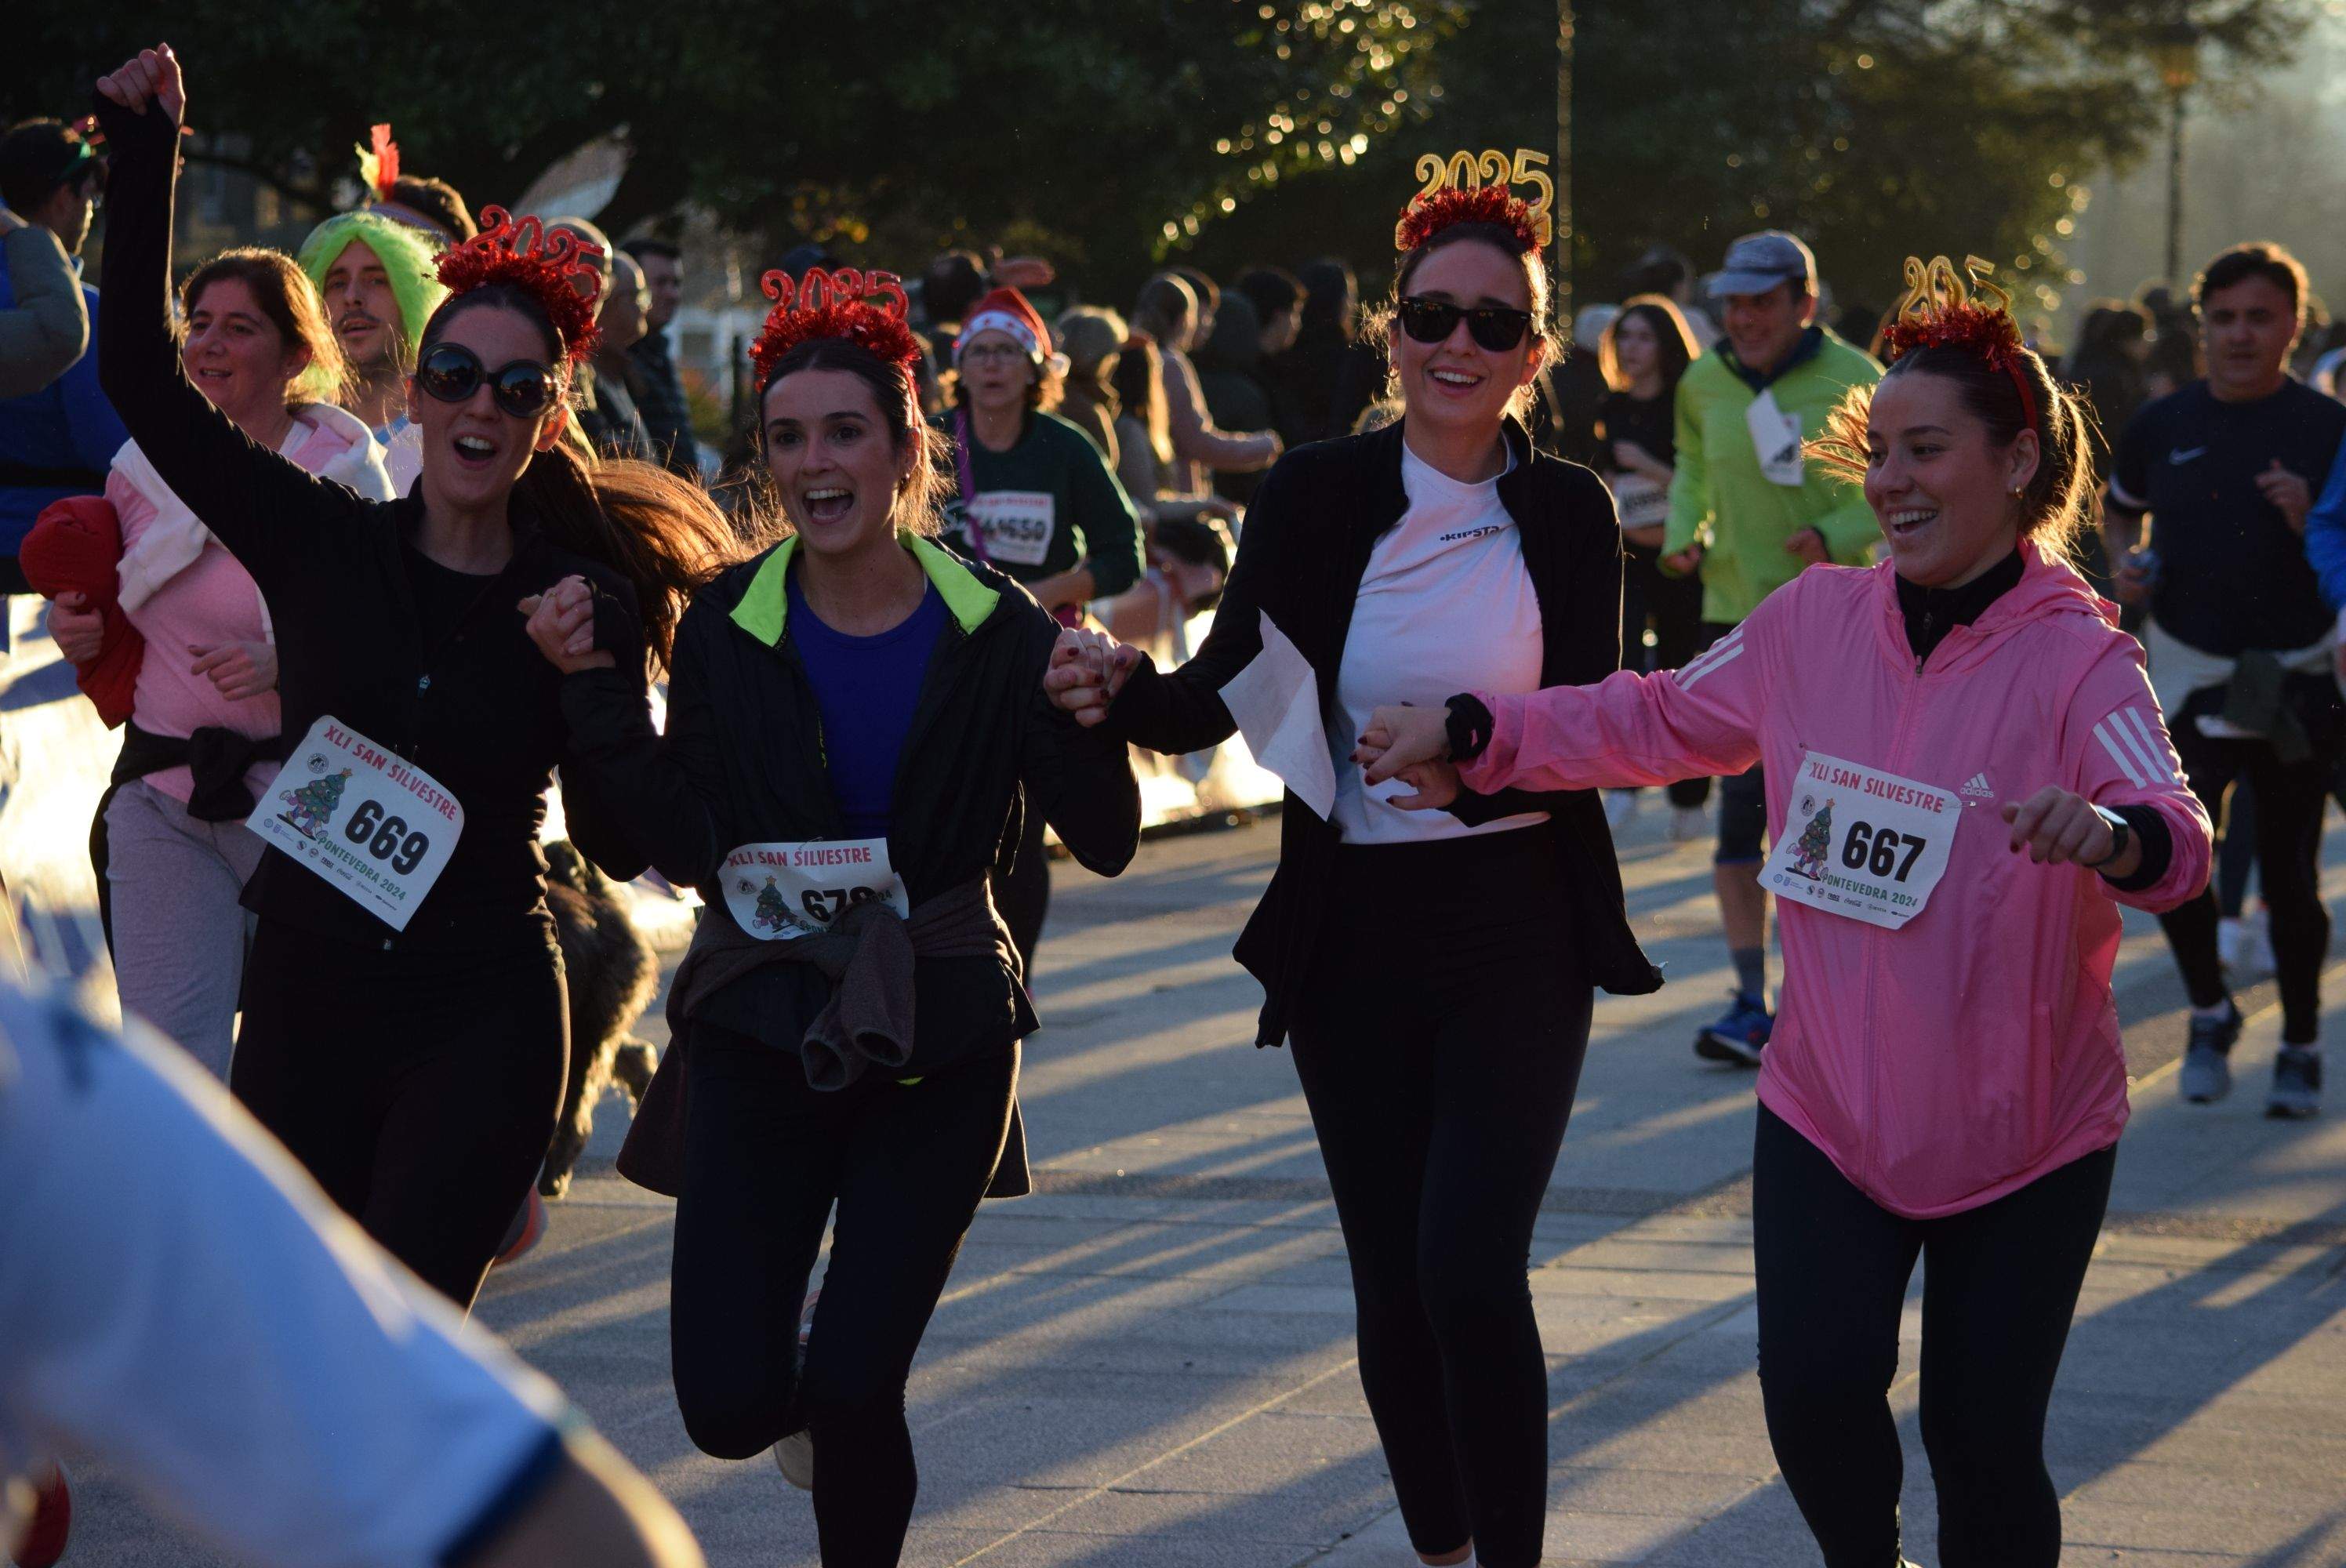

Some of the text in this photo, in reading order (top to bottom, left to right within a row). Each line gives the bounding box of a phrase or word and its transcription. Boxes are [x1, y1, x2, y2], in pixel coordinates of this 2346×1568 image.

[1407, 148, 1553, 217] 2025
[459, 204, 605, 303] 2025
[760, 267, 910, 328] 2025
[323, 724, 354, 750] XLI
[352, 743, 388, 771] SAN
[387, 764, 457, 822] SILVESTRE
[1808, 761, 1945, 814] XLI SAN SILVESTRE
[1960, 787, 1994, 797] adidas
[345, 799, 430, 876] 669
[728, 847, 873, 867] XLI SAN SILVESTRE
[1842, 820, 1927, 883] 667
[318, 837, 407, 902] PONTEVEDRA 2024
[1821, 873, 1887, 901] PONTEVEDRA
